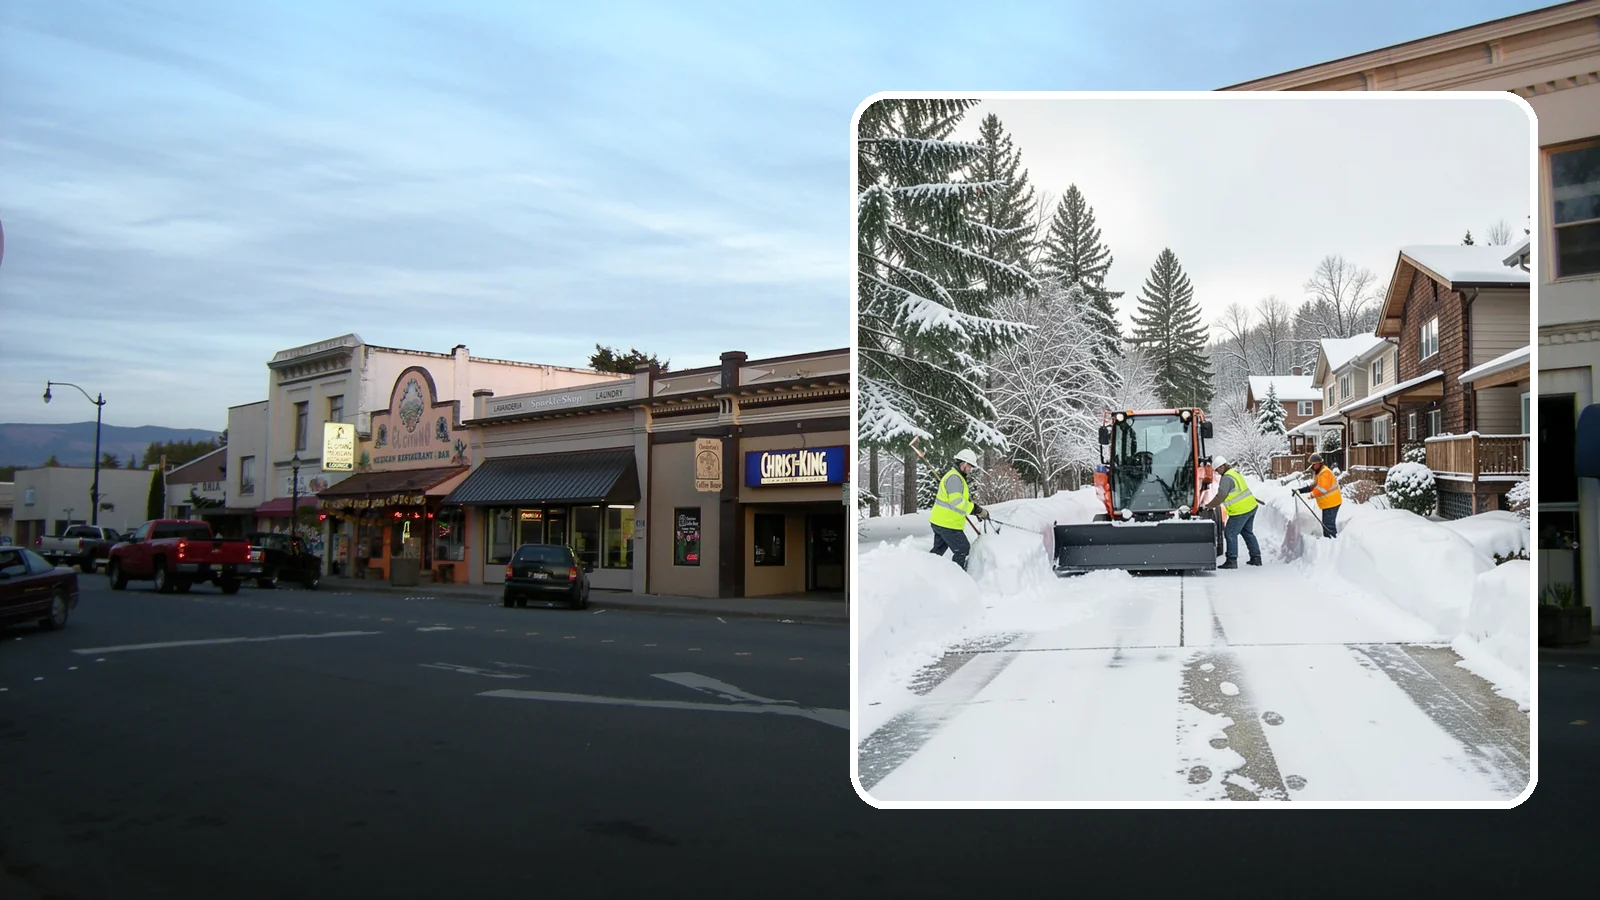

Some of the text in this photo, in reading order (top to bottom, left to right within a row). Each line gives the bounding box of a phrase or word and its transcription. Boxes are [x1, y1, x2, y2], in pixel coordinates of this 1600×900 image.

[493, 389, 623, 412] LAVANDERIA Sparkle Shop LAUNDRY
[392, 425, 402, 449] EL
[374, 455, 396, 464] MEXICAN
[397, 451, 433, 462] RESTAURANT
[438, 450, 450, 459] BAR
[761, 450, 827, 478] CHRIST KING
